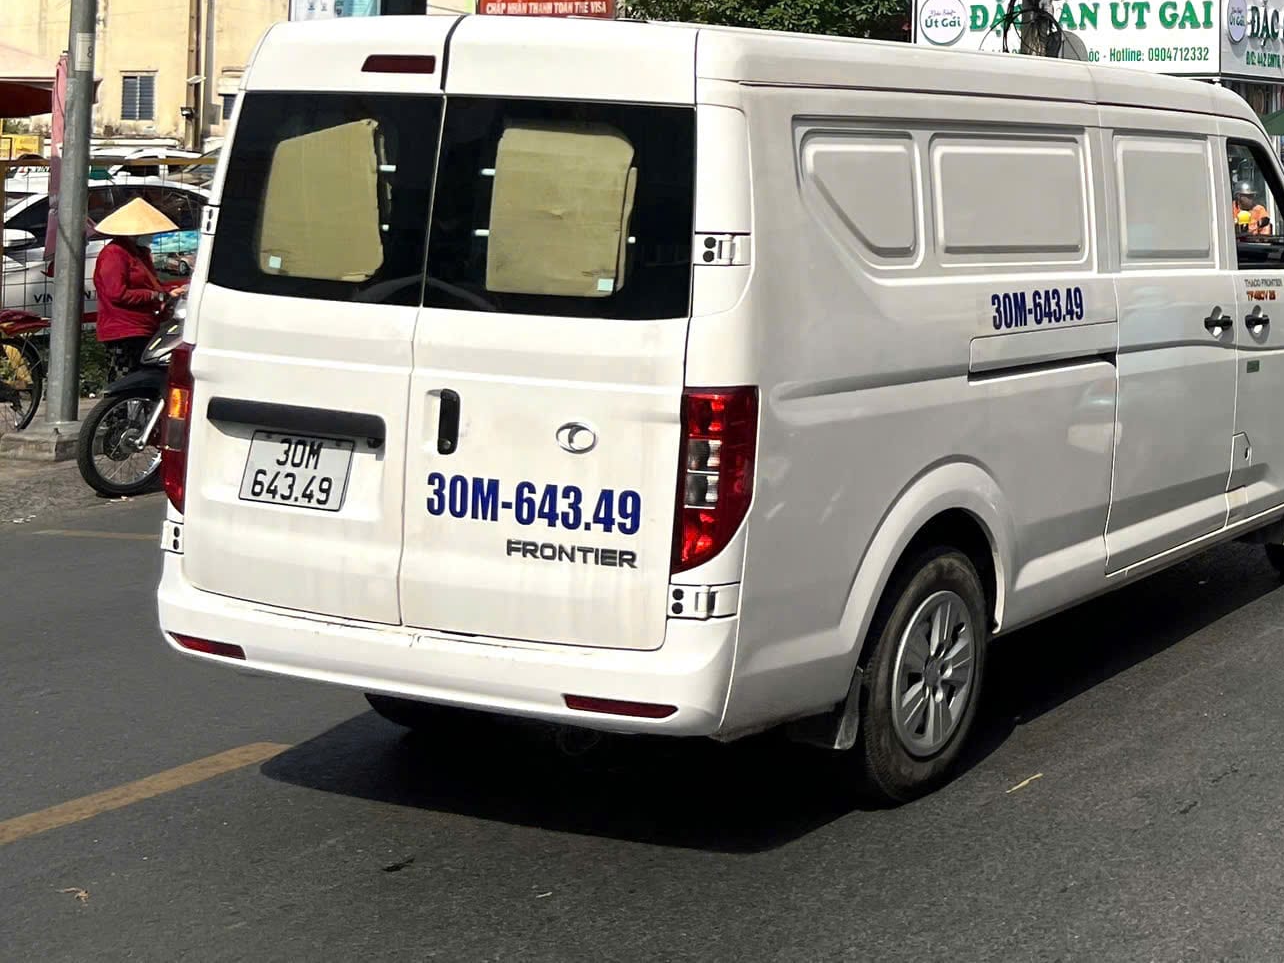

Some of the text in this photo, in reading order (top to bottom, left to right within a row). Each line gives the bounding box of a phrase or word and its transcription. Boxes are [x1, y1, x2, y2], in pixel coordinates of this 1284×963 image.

[590, 1, 607, 13] VISA
[925, 15, 961, 28] Út Gái
[1109, 47, 1145, 62] Hotline:
[1147, 47, 1210, 62] 0904712332
[991, 286, 1085, 331] 30M-643.49
[276, 438, 321, 470] 30M
[250, 468, 333, 507] 643.49
[426, 472, 642, 536] 30M-643.49
[506, 538, 638, 569] FRONTIER
